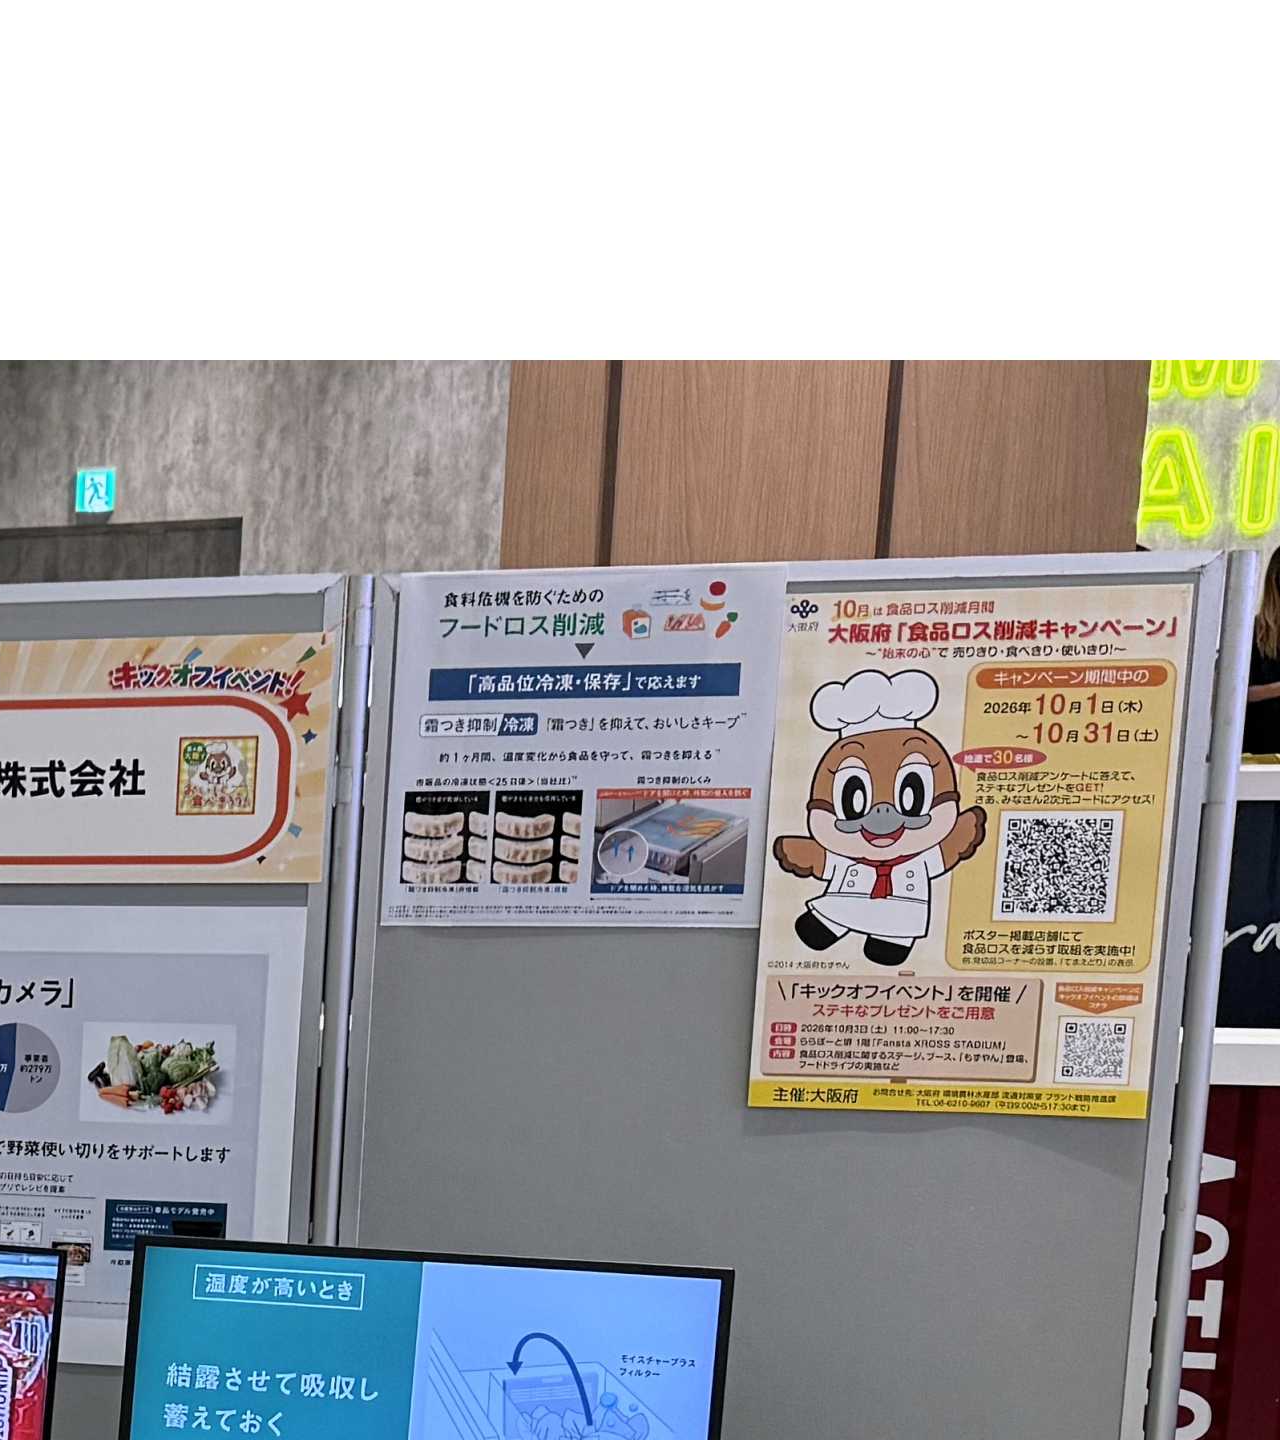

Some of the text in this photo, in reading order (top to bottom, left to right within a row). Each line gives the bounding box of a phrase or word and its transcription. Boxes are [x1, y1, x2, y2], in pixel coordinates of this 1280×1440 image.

[443, 589, 604, 608] 食料危機を防ぐための
[439, 611, 606, 639] フードロス削減
[827, 615, 1179, 645] 大阪府「食品ロス削減キャンペーン」
[467, 672, 702, 694] 「高品位冷凍・保存」で応えます
[993, 669, 1150, 685] キャンペーン期間中の
[502, 716, 535, 733] 冷凍
[962, 930, 1084, 943] ポスター掲載店舗にて
[790, 982, 1012, 1004] 「キックオフイベント」を開催
[811, 1004, 995, 1020] ステキなプレゼントをご用意
[913, 1040, 952, 1049] XROSS
[165, 1362, 380, 1402] 結露させて吸収し
[619, 1366, 661, 1379] フィルター
[162, 1403, 284, 1437] 蓄えておく
